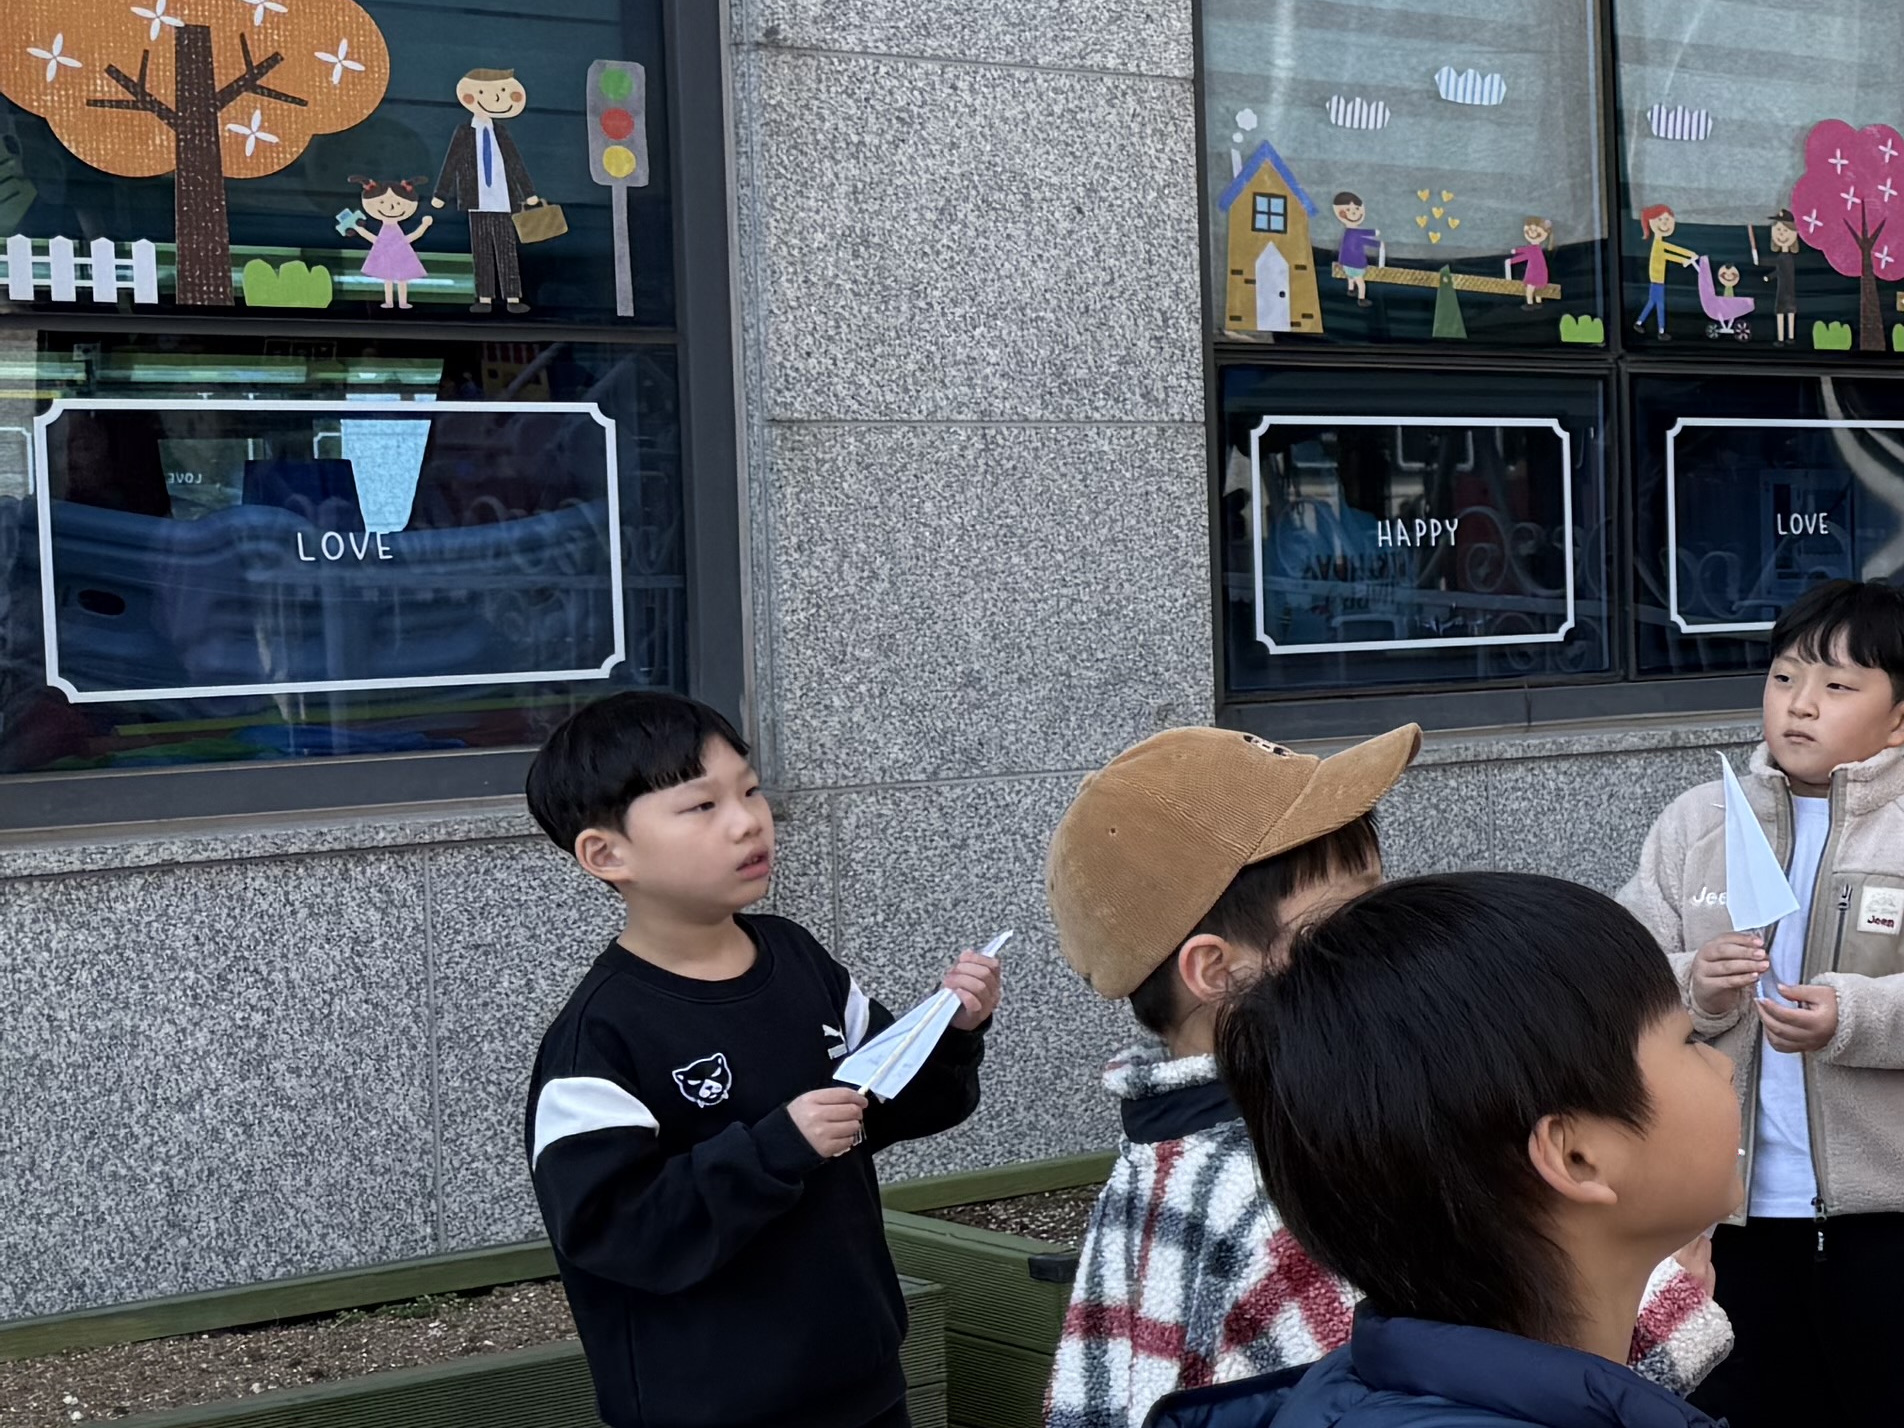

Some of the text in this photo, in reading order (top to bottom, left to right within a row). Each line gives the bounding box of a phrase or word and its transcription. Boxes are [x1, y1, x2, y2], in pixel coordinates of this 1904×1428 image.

[1376, 517, 1459, 548] HAPPY
[1776, 512, 1829, 535] LOVE
[297, 530, 394, 562] LOVE
[1692, 886, 1728, 907] Jee
